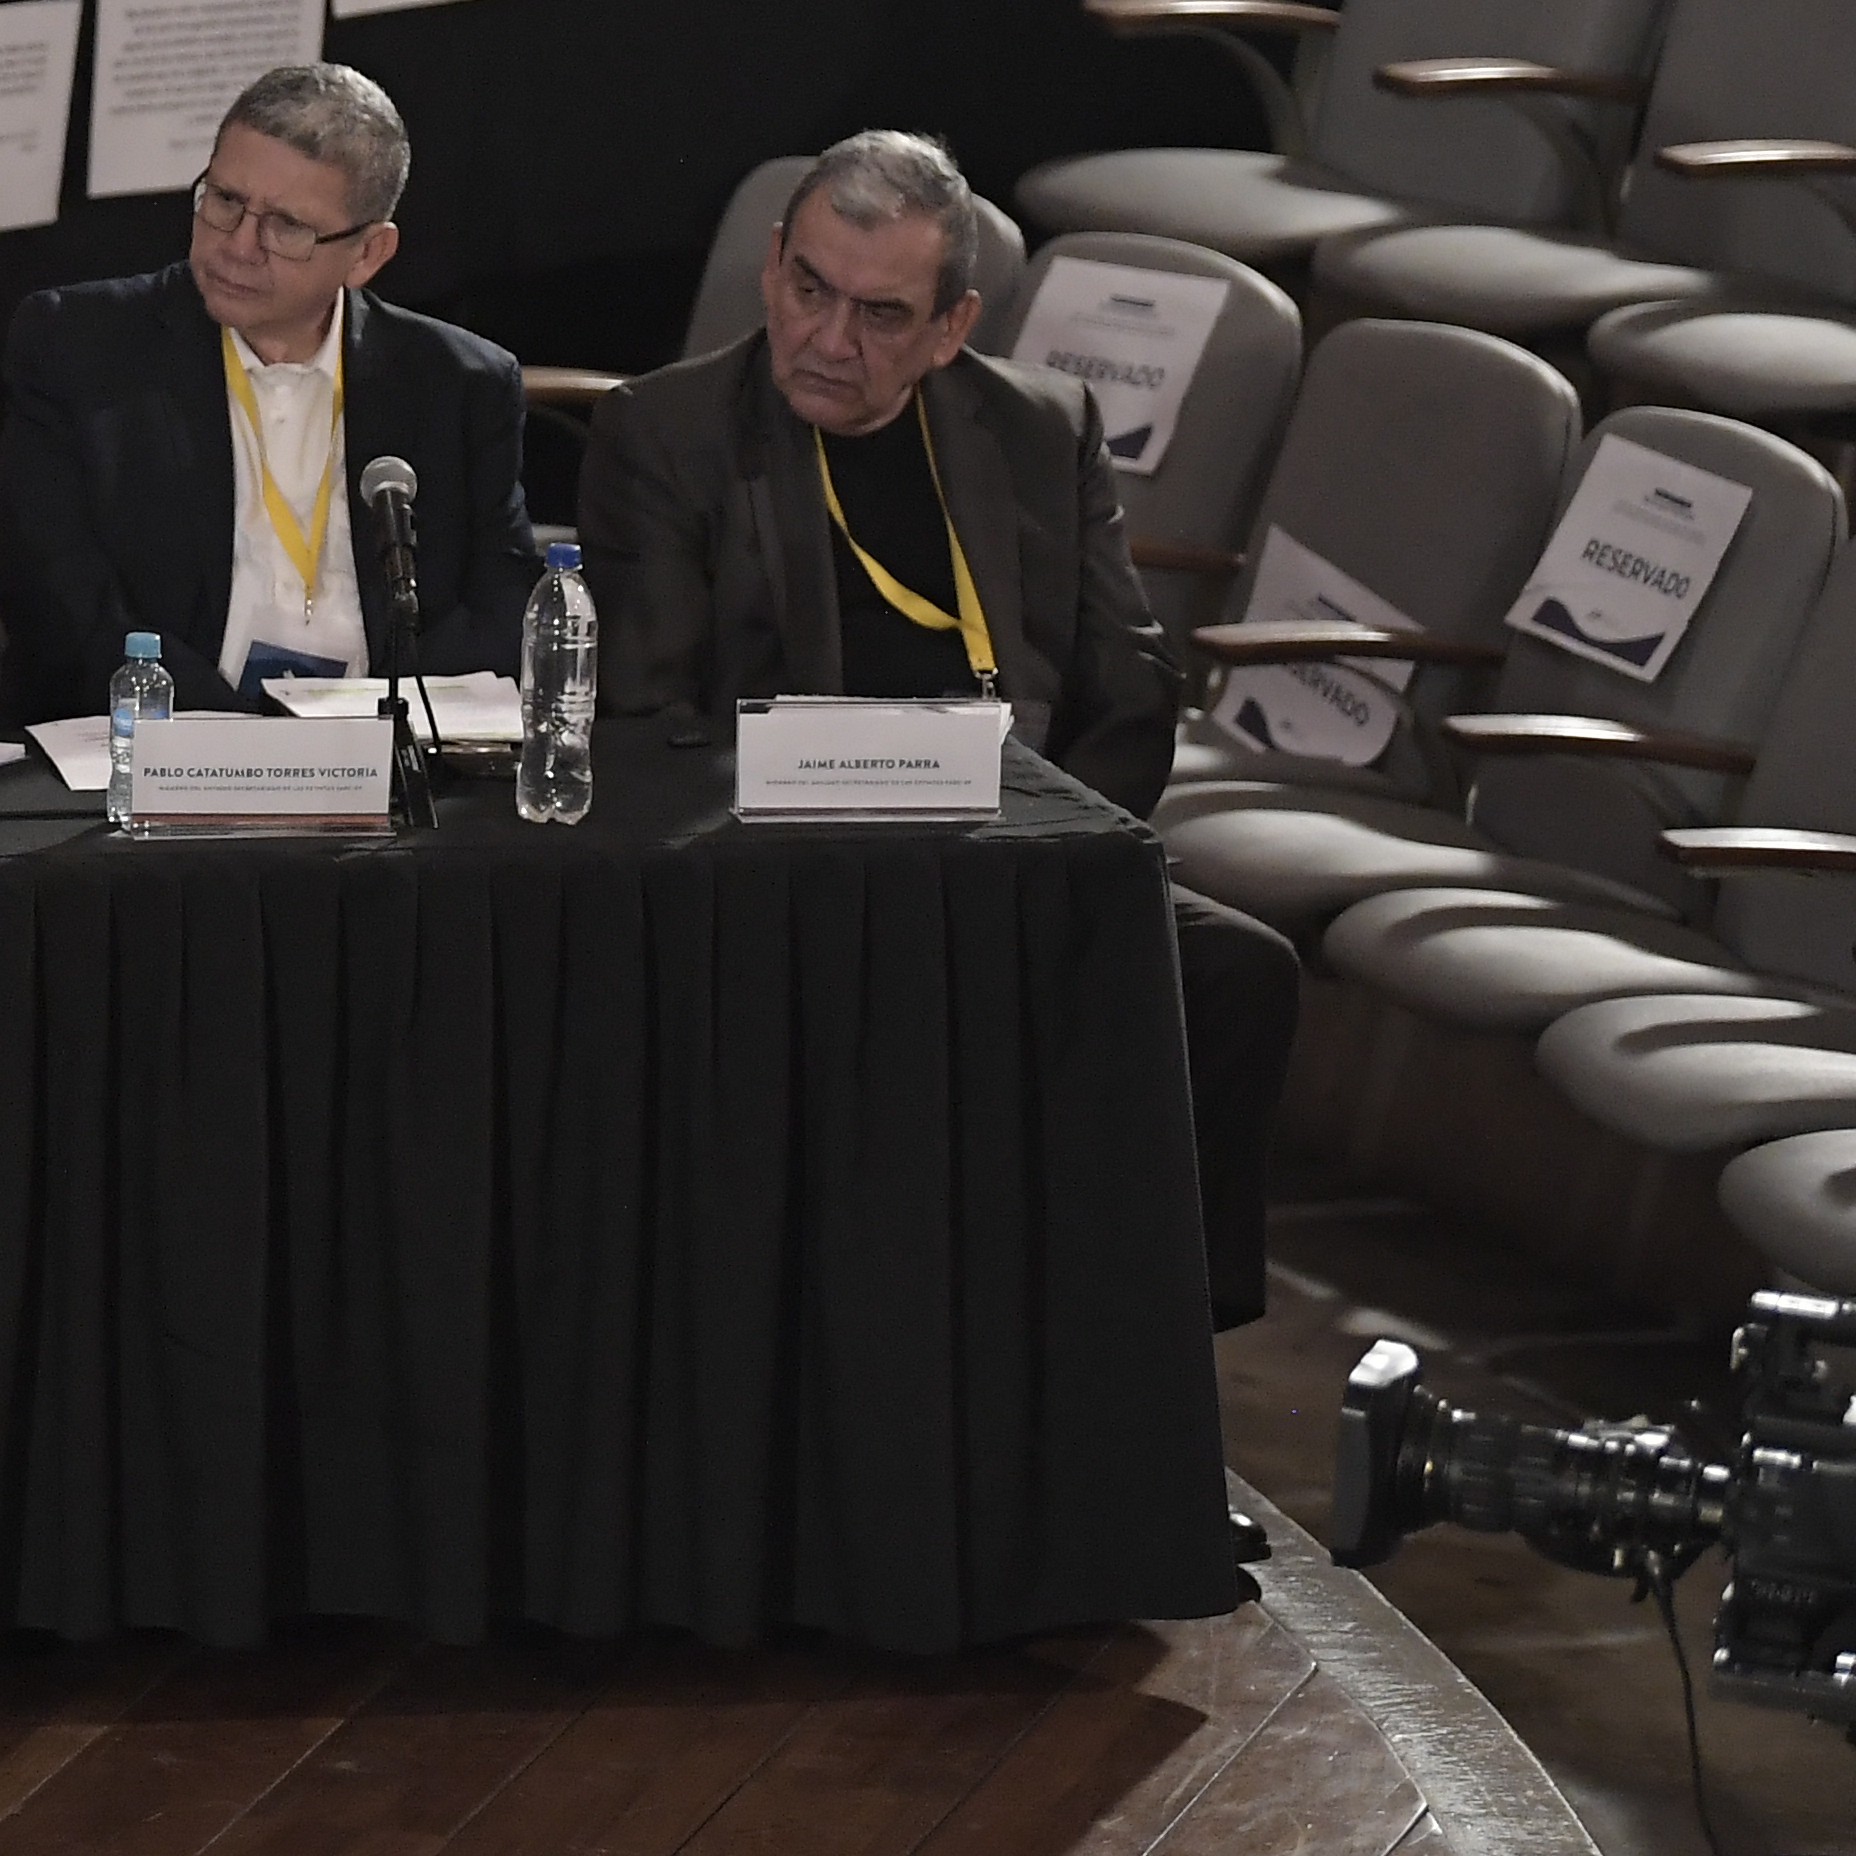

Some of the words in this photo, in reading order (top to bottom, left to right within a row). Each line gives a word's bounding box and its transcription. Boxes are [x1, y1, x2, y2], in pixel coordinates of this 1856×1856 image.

[1046, 349, 1166, 389] RESERVADO
[1582, 538, 1691, 599] RESERVADO
[143, 767, 184, 778] PABLO
[187, 767, 264, 778] CATATUMBO
[266, 767, 315, 778] TORRES
[318, 767, 378, 778] VICTORIA
[798, 758, 835, 770] JAIME
[839, 758, 895, 770] ALBERTO
[899, 758, 940, 770] PARRA
